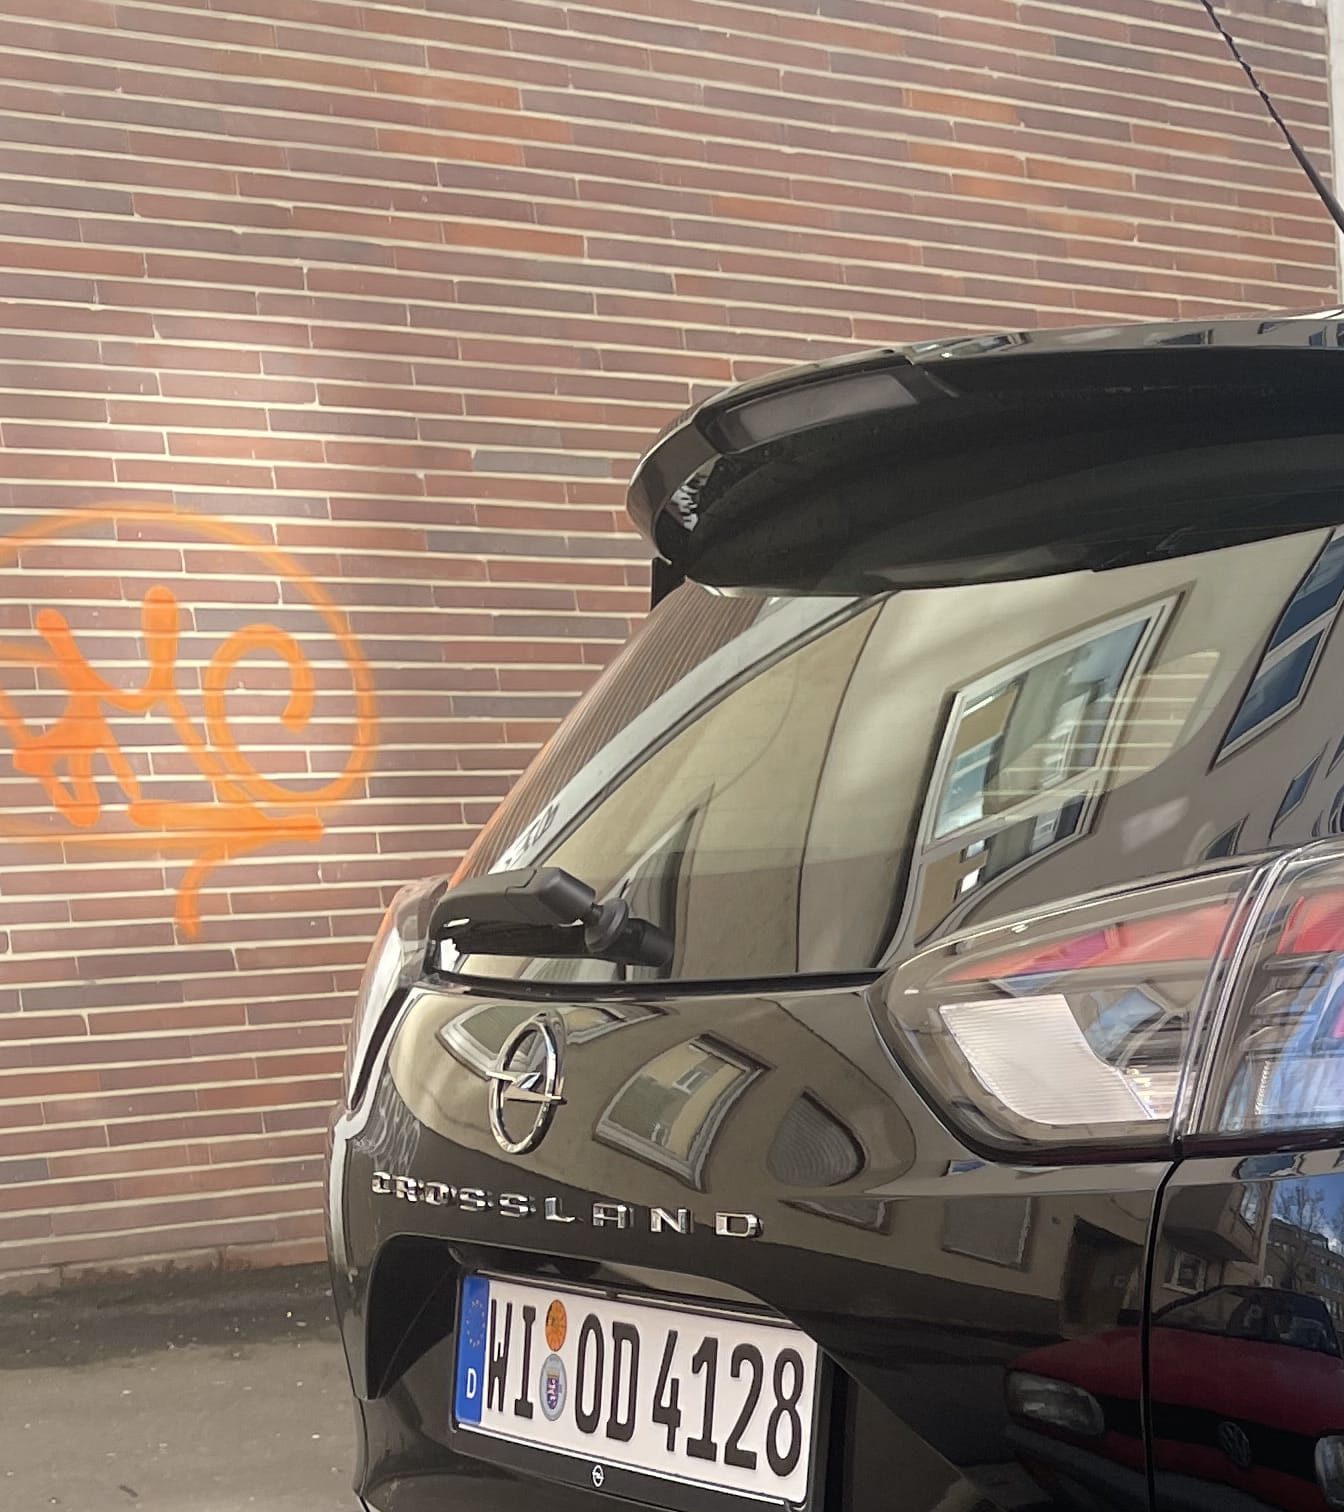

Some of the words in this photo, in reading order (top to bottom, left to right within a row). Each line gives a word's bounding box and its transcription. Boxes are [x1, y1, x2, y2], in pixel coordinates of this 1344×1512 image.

[371, 1170, 765, 1239] CROSSLAND
[465, 1367, 478, 1400] D
[486, 1298, 537, 1420] WI
[574, 1313, 641, 1443] OD
[651, 1329, 805, 1478] 4128
